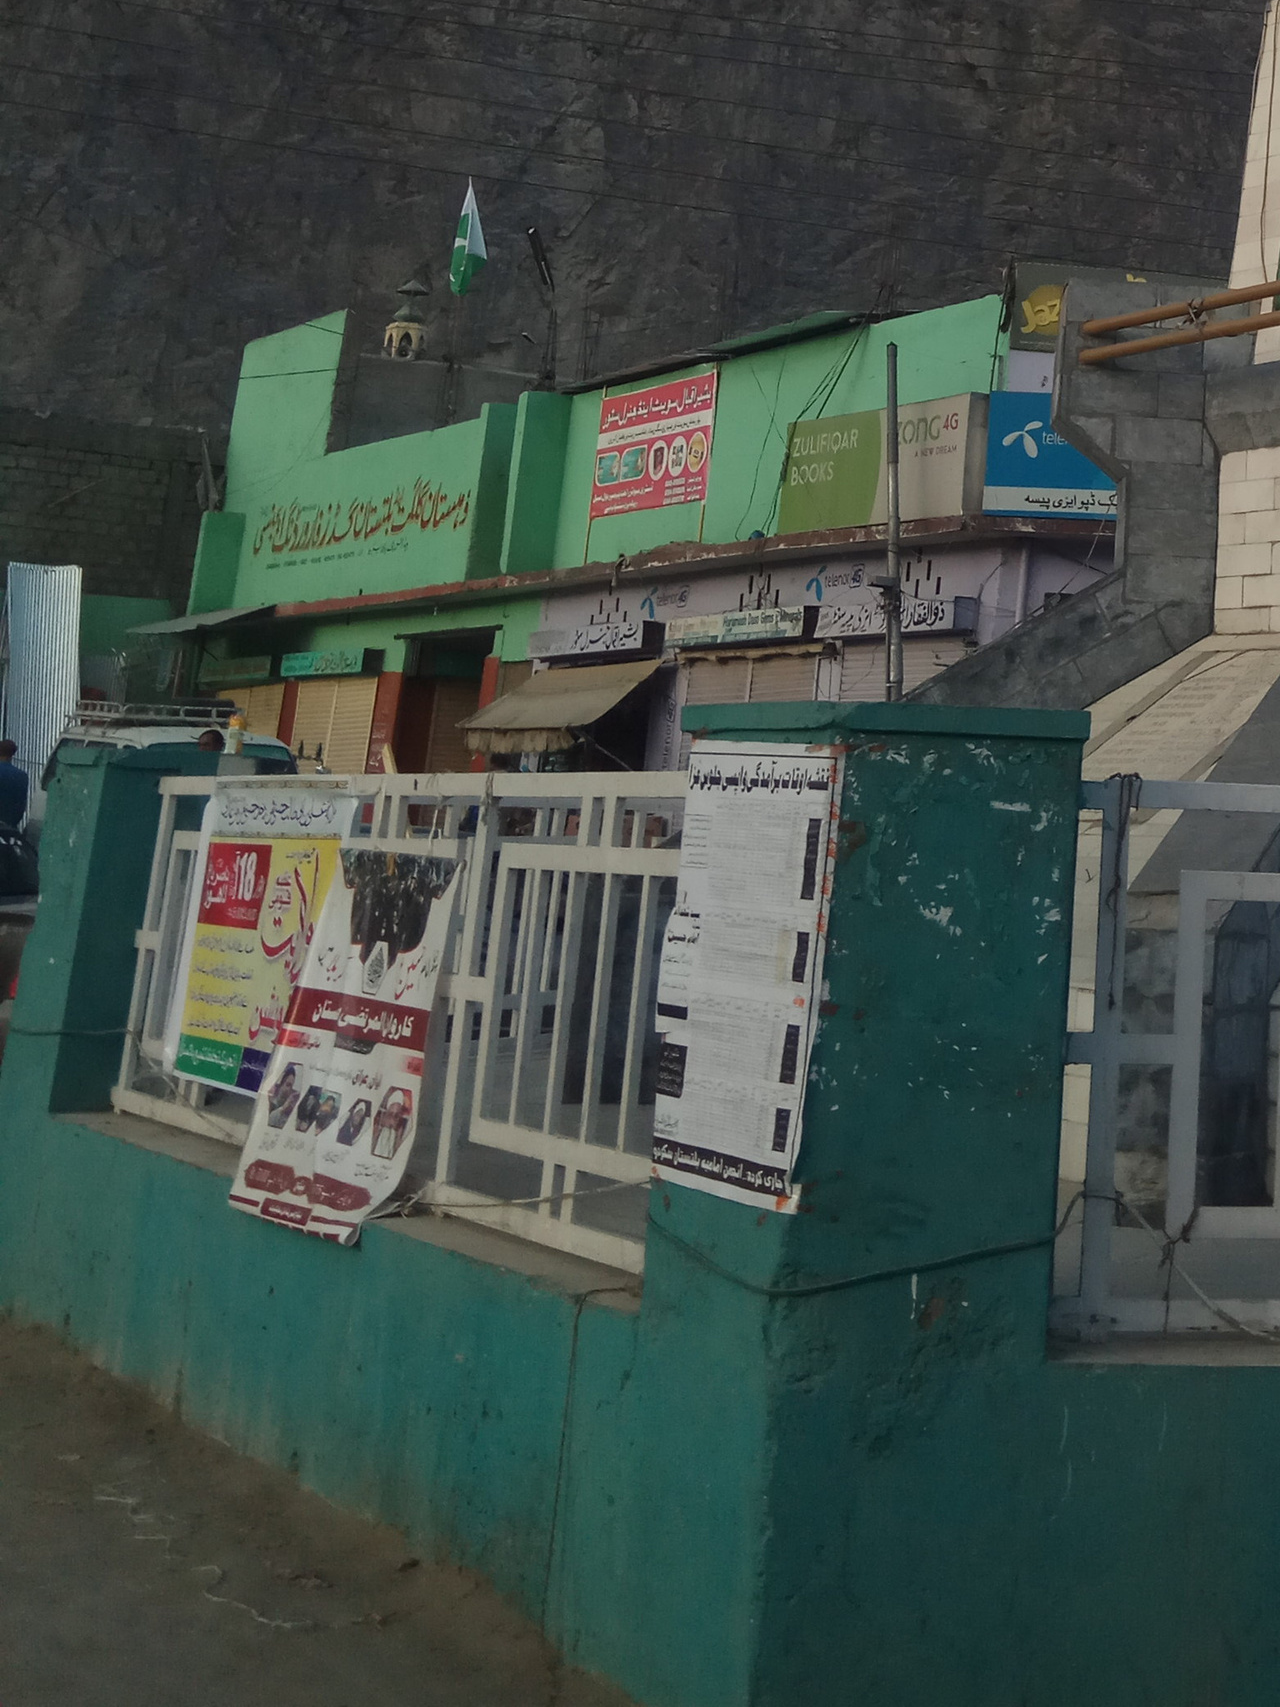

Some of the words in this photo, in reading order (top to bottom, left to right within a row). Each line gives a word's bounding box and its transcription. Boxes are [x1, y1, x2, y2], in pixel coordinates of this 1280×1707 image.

[943, 412, 959, 431] 4G
[791, 429, 859, 458] ZULIFIQAR
[920, 448, 934, 458] NEW
[935, 445, 957, 456] DREAM
[790, 461, 835, 487] BOOKS
[1024, 495, 1051, 510] پیسہ
[1052, 494, 1077, 508] ایزی
[782, 768, 808, 796] اوقات
[807, 767, 830, 791] نقشہ
[237, 851, 258, 902] 18
[652, 1143, 674, 1161] سکردو
[673, 1147, 701, 1167] بلتستان
[764, 1171, 784, 1191] جاری
